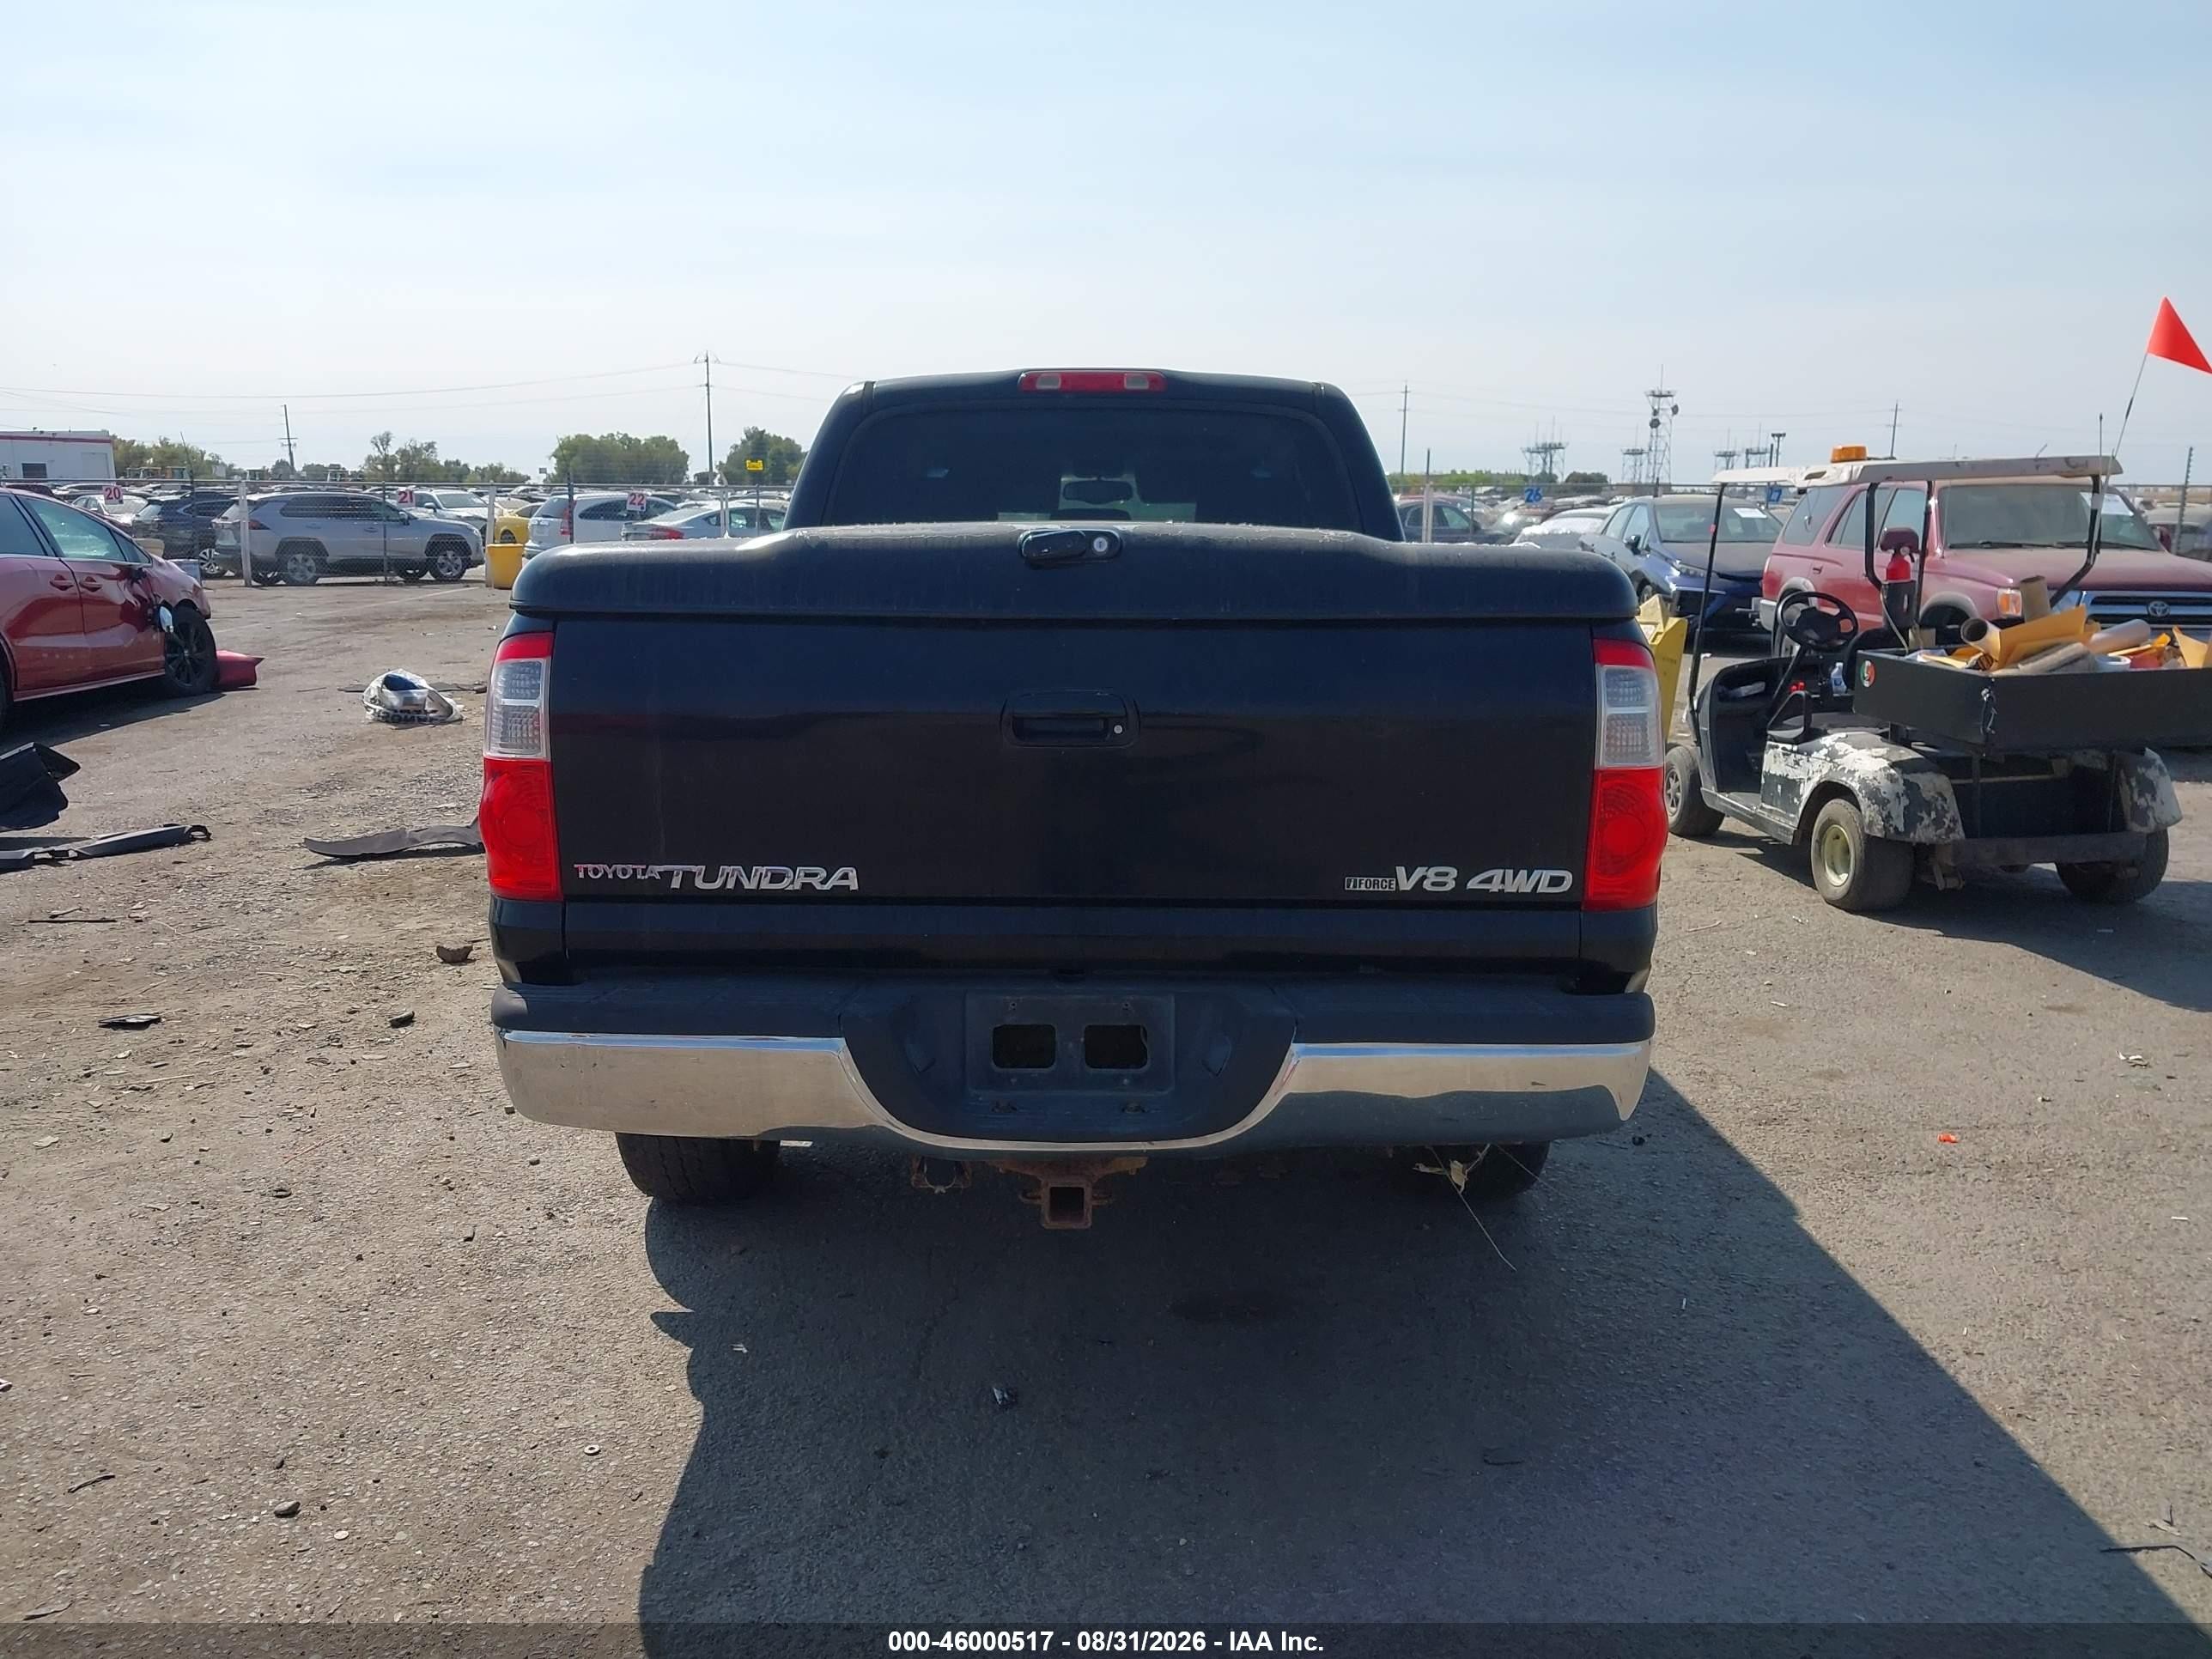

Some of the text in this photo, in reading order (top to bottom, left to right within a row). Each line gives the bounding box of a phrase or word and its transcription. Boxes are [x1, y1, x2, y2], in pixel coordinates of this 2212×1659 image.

[105, 487, 121, 500] 20
[398, 490, 414, 503] 21
[629, 493, 645, 506] 22
[1525, 488, 1542, 502] 26
[574, 864, 859, 891] TOYOTA TUNDRA
[1395, 866, 1458, 891] V8
[1466, 868, 1573, 893] 4WD
